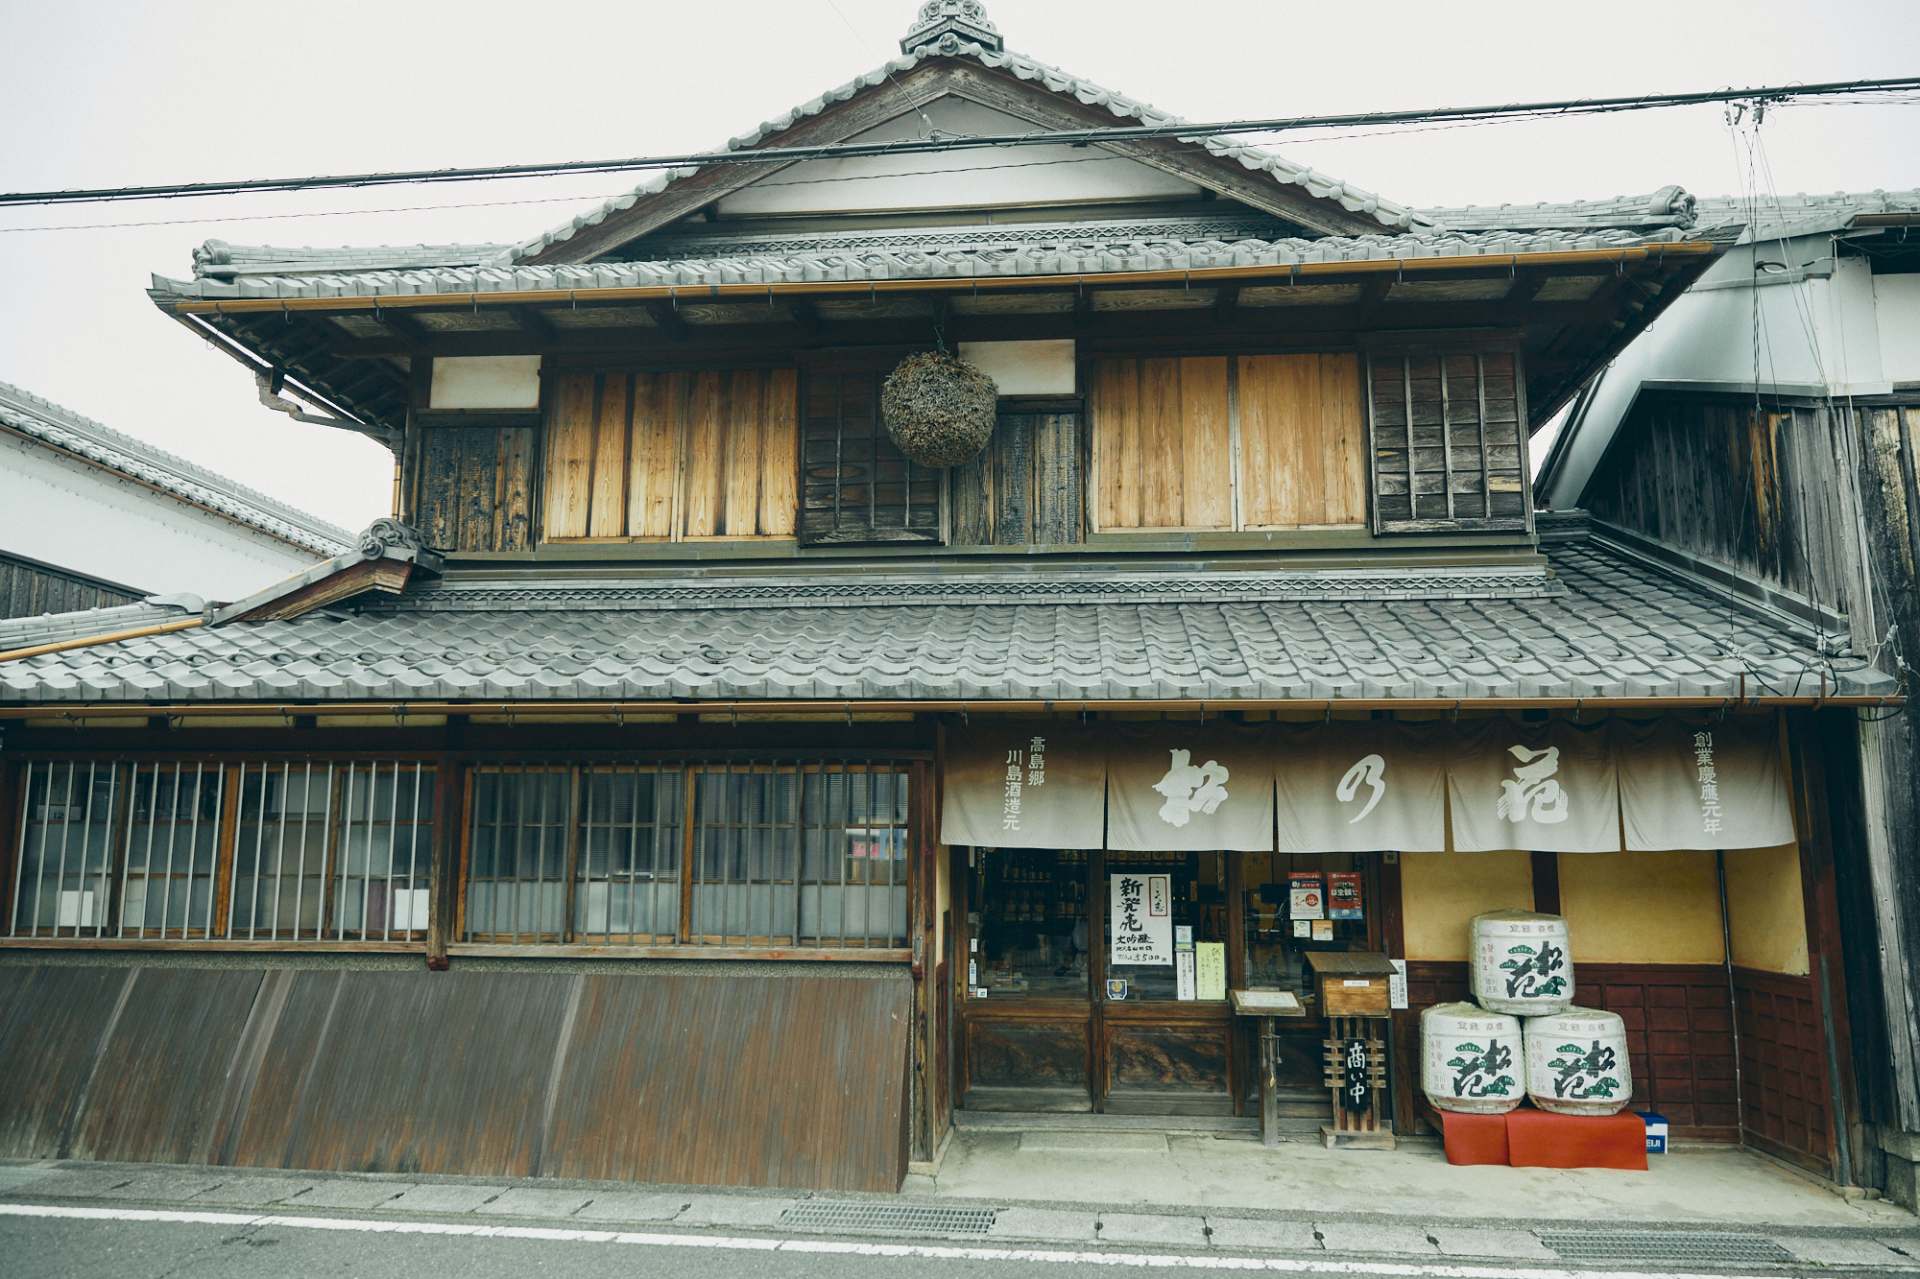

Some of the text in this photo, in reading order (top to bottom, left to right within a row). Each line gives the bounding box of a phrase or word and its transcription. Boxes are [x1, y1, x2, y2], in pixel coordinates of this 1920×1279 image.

[1002, 749, 1023, 831] 川島酒造元
[1028, 736, 1046, 786] 高島郷
[1693, 731, 1723, 837] 創業慶應元年
[1347, 1042, 1366, 1105] 商い中
